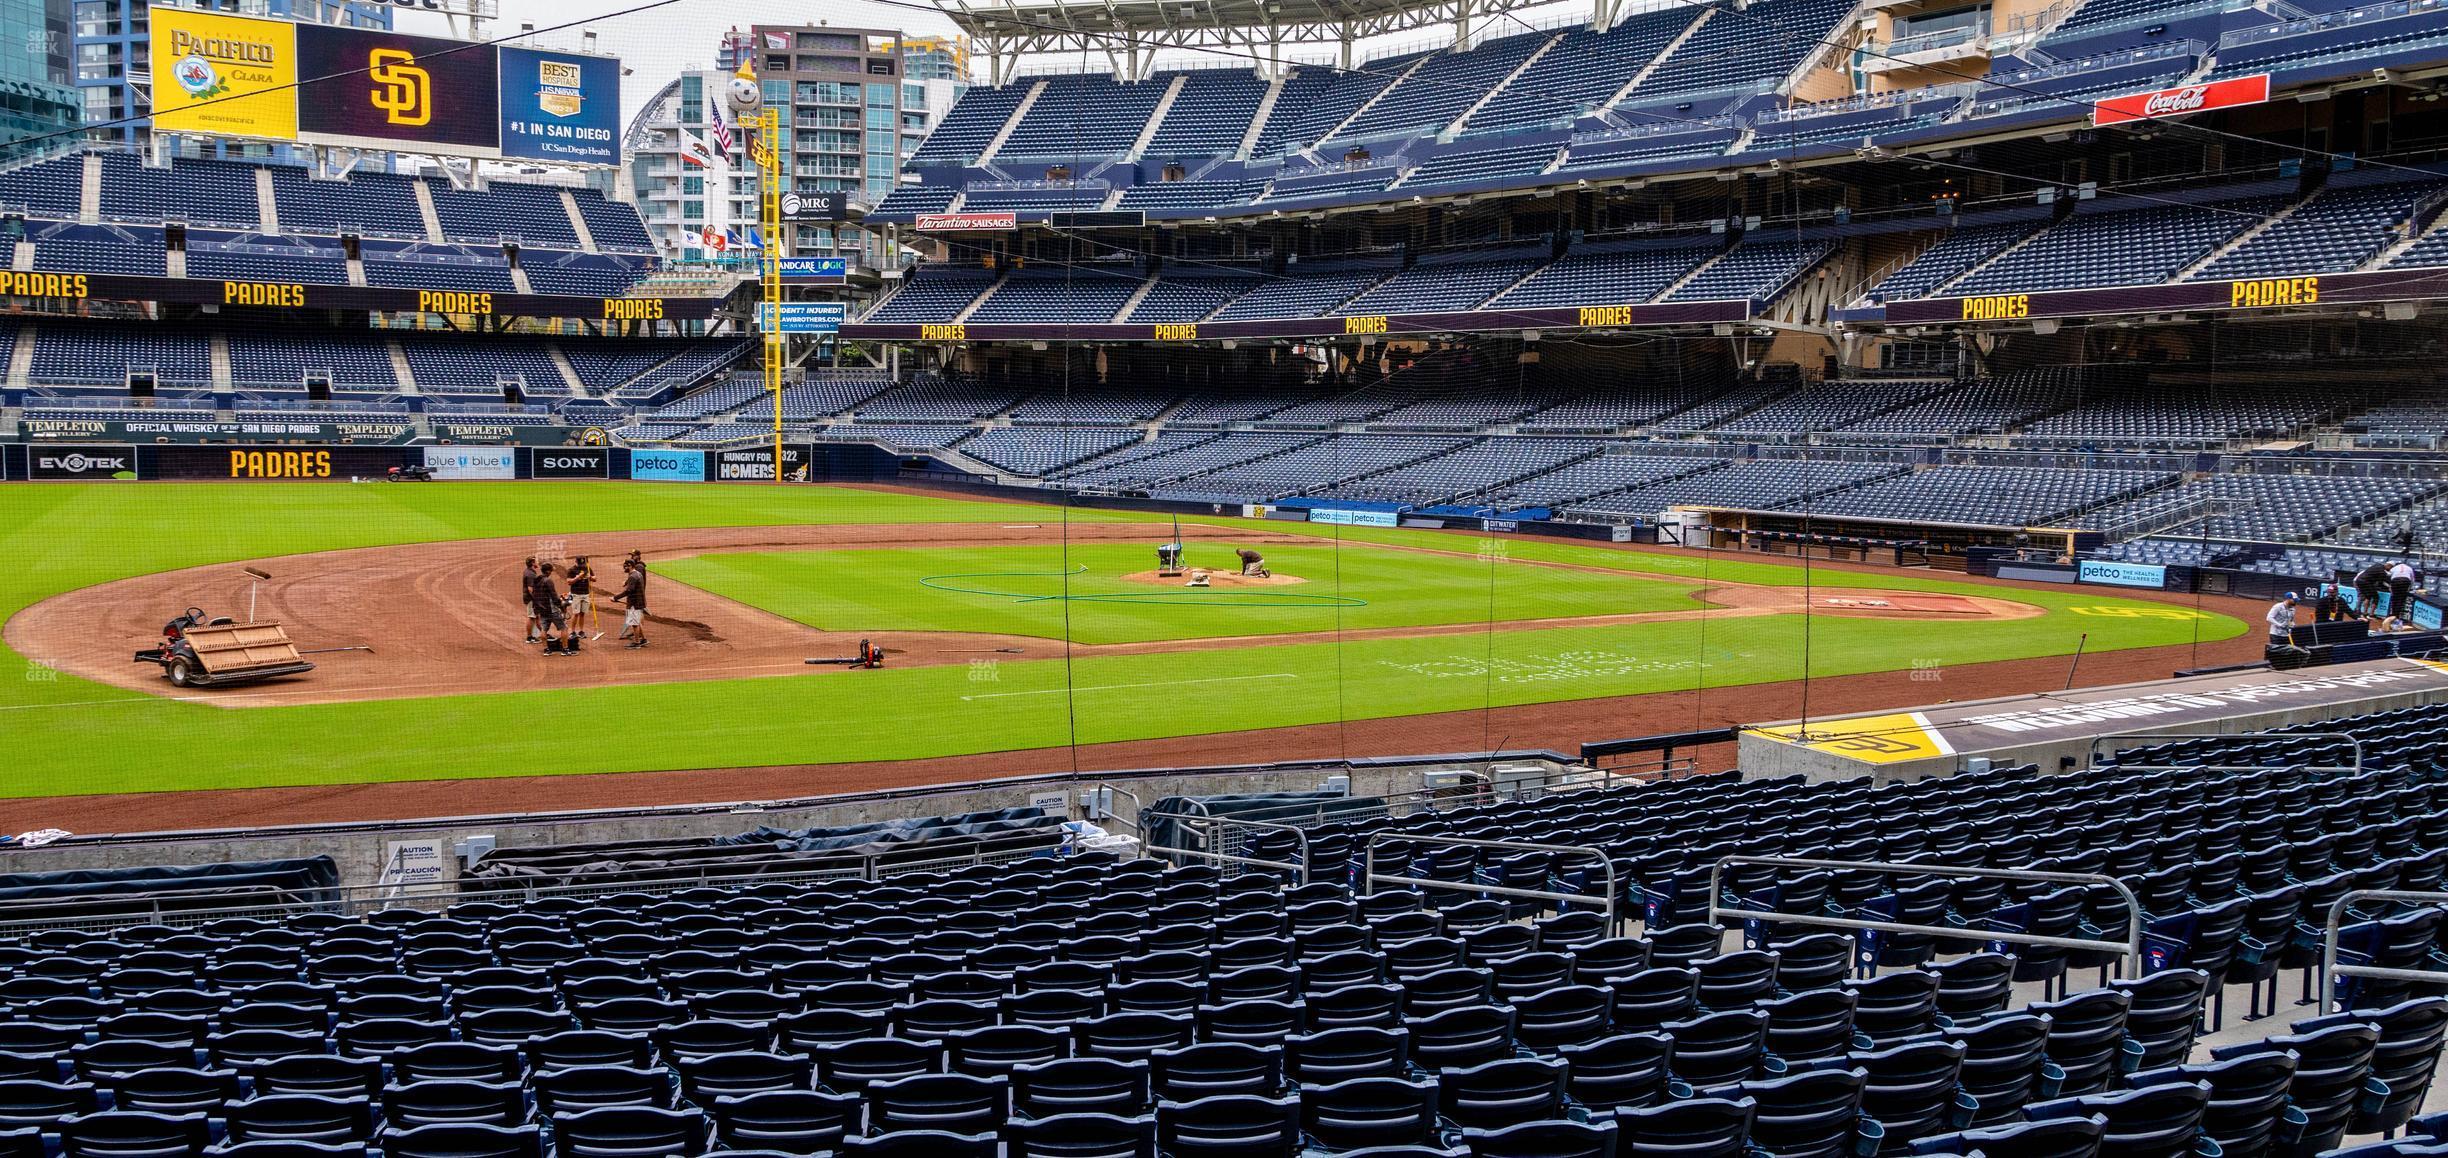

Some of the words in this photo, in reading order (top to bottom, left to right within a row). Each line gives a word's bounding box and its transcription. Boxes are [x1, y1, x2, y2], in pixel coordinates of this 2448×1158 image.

[171, 29, 274, 63] PACIFICO
[231, 69, 273, 83] CLARA
[543, 64, 578, 78] BEST
[543, 76, 578, 87] HOSPITALS
[2144, 86, 2210, 115] Coca-Cola
[511, 121, 526, 134] #1
[531, 123, 544, 135] IN
[547, 124, 572, 138] SAN
[576, 127, 611, 141] DIEGO
[541, 143, 553, 151] UC
[554, 144, 568, 153] San
[568, 146, 588, 156] Diego
[588, 147, 611, 156] Health
[801, 197, 830, 209] MRC
[918, 216, 971, 229] Tarantino
[971, 218, 1013, 228] SAUSAGES
[818, 261, 844, 270] LOGIC
[0, 271, 88, 298] PADRES
[224, 281, 305, 307] PADRES
[2231, 277, 2319, 307] PADRES
[419, 291, 492, 314] PADRES
[604, 298, 663, 319] PADRES
[1963, 295, 2029, 320] PADRES
[1580, 306, 1631, 326] PADRES
[1346, 316, 1387, 333] PADRES
[921, 324, 966, 340] PADRES
[1155, 324, 1197, 340] PADRES
[25, 421, 107, 433] TEMPLETON
[126, 423, 172, 433] OFFICIAL
[173, 423, 219, 433] WHISKEY
[242, 424, 260, 434] SAN
[262, 424, 286, 434] DIEGO
[288, 424, 320, 434] PADRES
[336, 424, 406, 435] TEMPLETON
[447, 425, 514, 436] TEMPLETON
[427, 456, 455, 466] blue
[472, 456, 499, 466] blue
[723, 452, 755, 462] HUNGRY
[756, 452, 772, 462] FOR
[781, 450, 797, 462] 322
[39, 453, 126, 473] EVOTEK
[230, 450, 331, 478] PADRES
[543, 457, 600, 469] SONY
[635, 456, 678, 472] petco
[720, 463, 776, 479] HOMERS
[1311, 512, 1331, 521] petco
[1354, 514, 1375, 523] petco
[2082, 566, 2120, 579] petco
[402, 846, 433, 854] AUTION
[390, 866, 441, 875] PRCAUCIÓN
